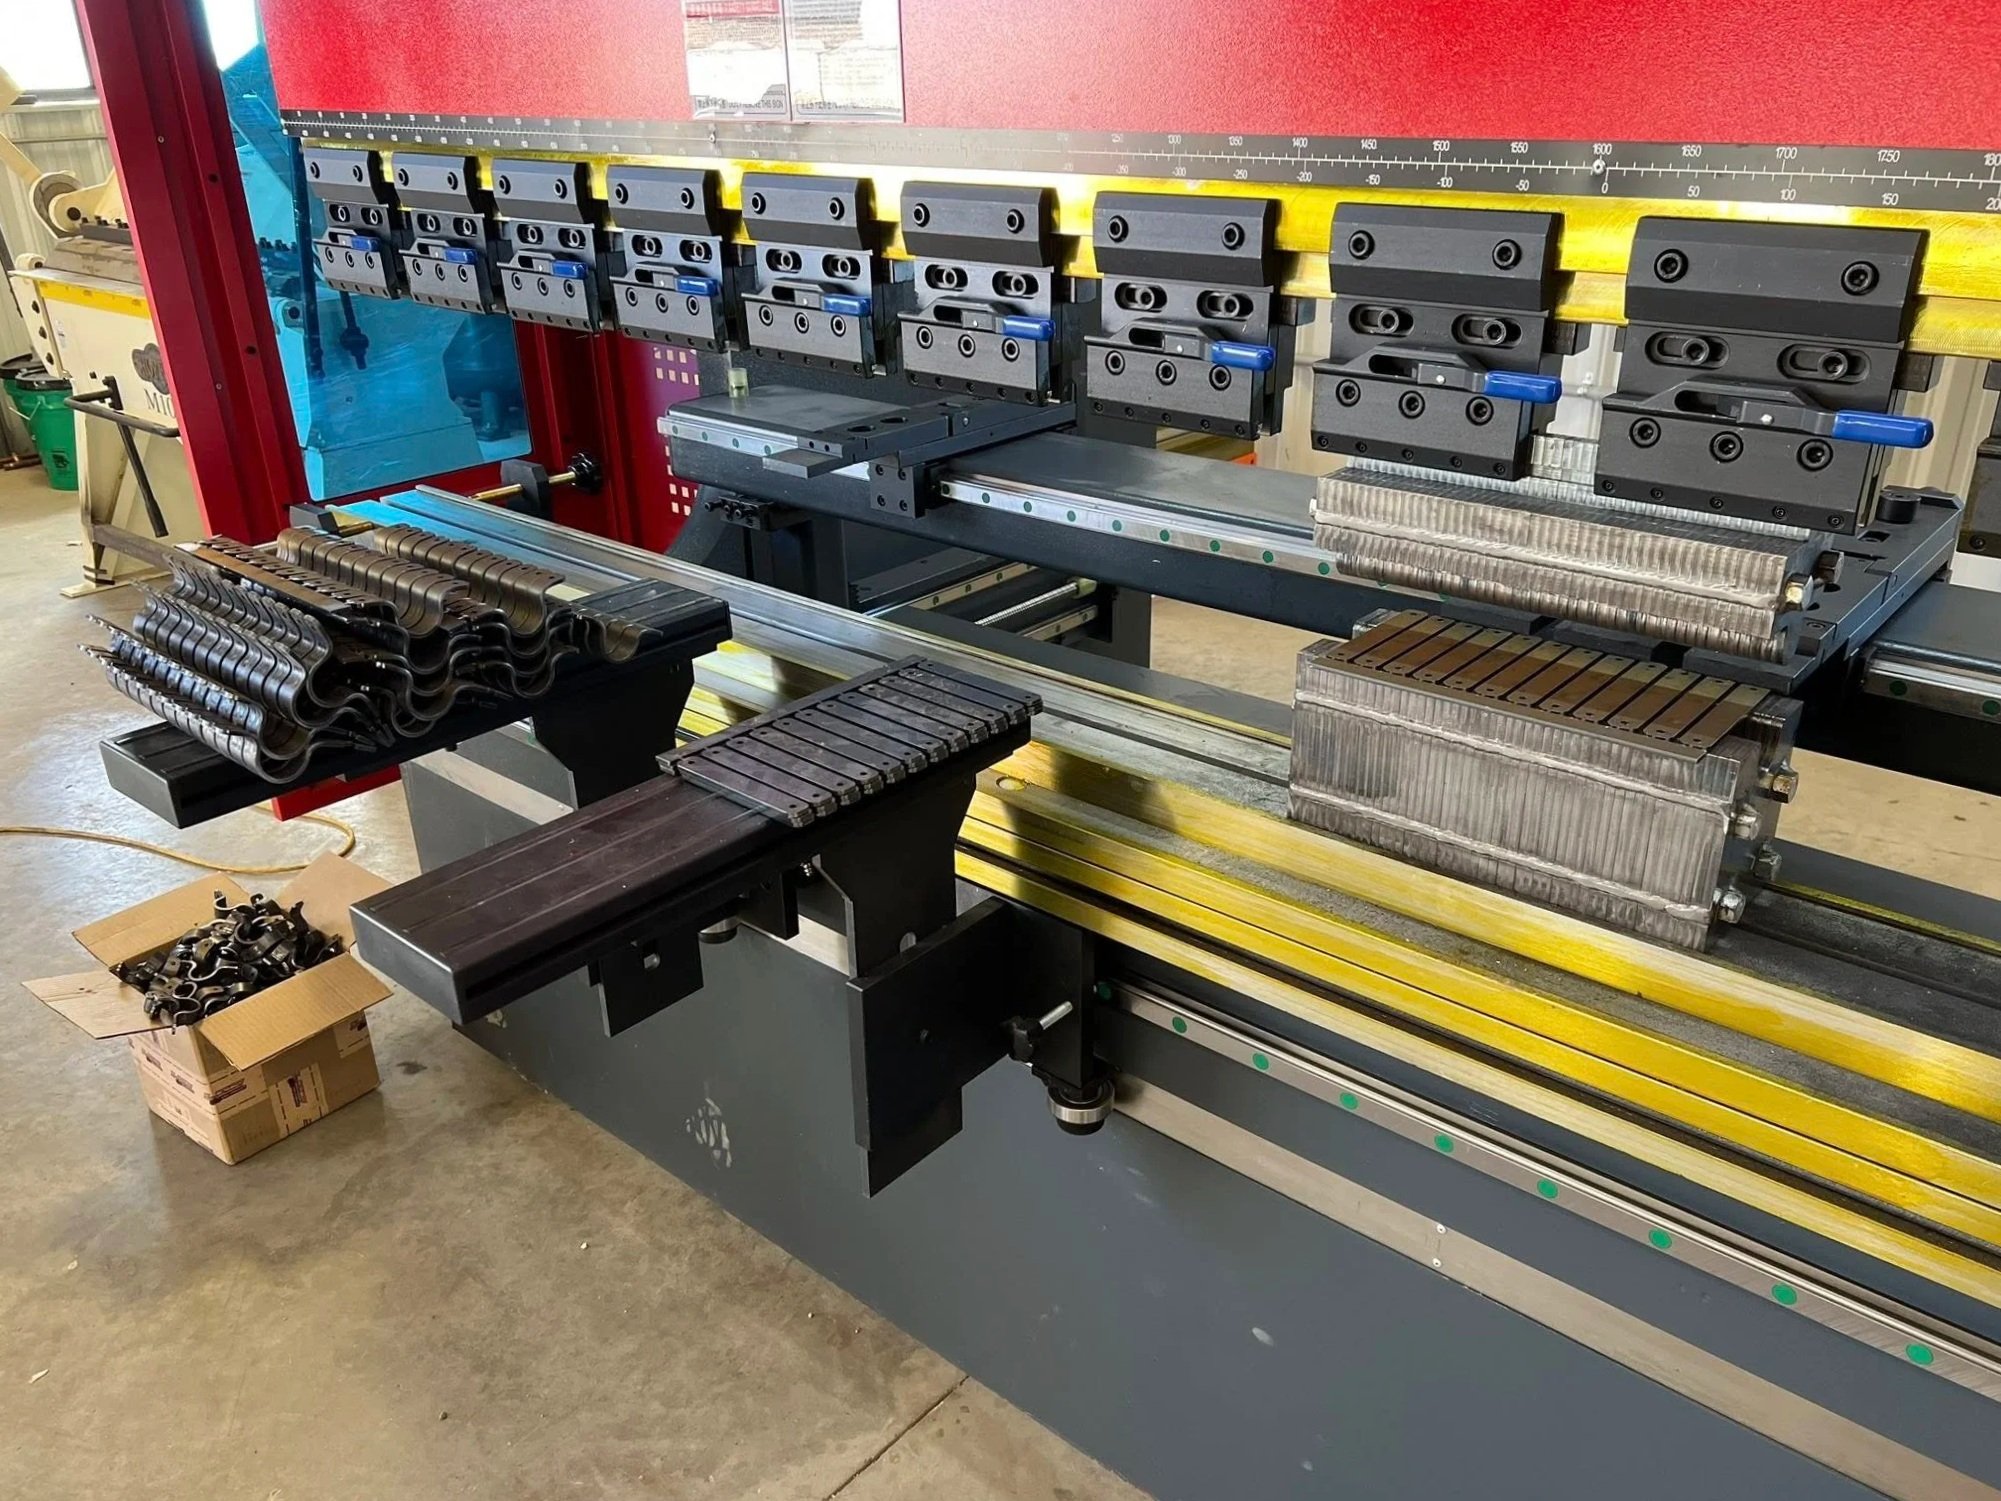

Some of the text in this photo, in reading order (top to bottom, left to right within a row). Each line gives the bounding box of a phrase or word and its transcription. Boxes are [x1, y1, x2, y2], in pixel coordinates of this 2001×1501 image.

[1167, 134, 1182, 144] 1300
[1228, 135, 1244, 146] 1350
[1291, 137, 1308, 148] 1400
[1360, 138, 1377, 150] 1450
[1432, 140, 1450, 151] 1500
[1510, 141, 1529, 153] 1550
[1592, 143, 1612, 155] 1600
[1681, 144, 1702, 157] 1650
[1776, 146, 1798, 159] 1700
[1877, 149, 1901, 163] 1750
[1171, 166, 1187, 177] -300
[1233, 168, 1249, 180] -250
[1296, 171, 1313, 182] -200
[1365, 174, 1381, 185] -150
[1436, 176, 1454, 188] -100
[1515, 179, 1530, 191] -50
[1601, 181, 1609, 194] 0
[1687, 185, 1701, 197] 50
[1779, 188, 1797, 201] 100
[1881, 192, 1900, 206] 150
